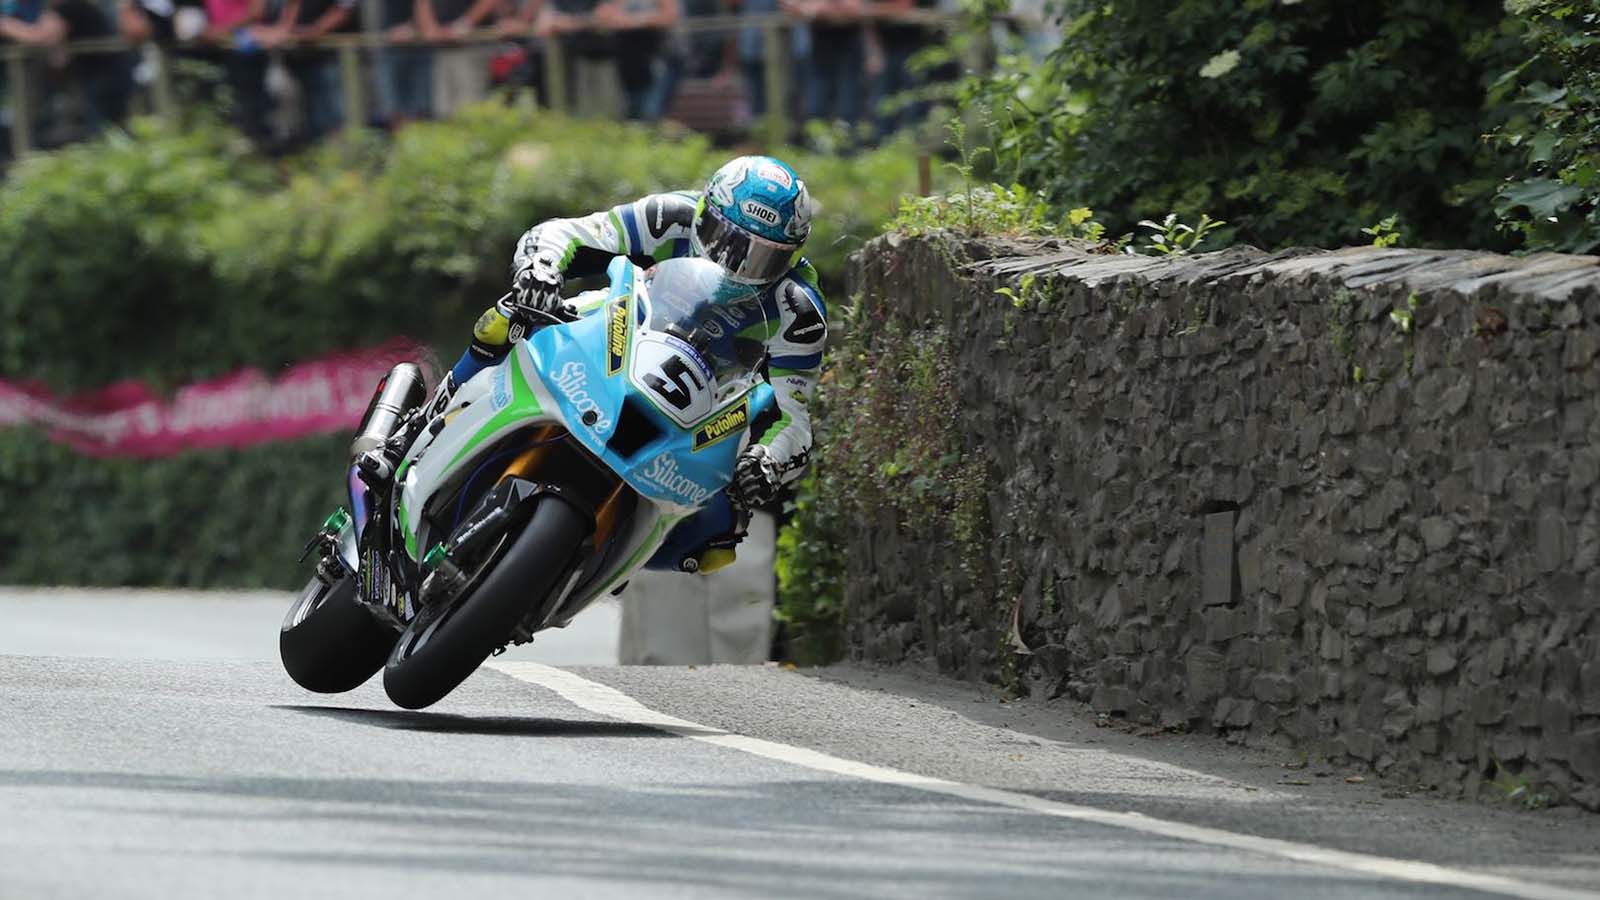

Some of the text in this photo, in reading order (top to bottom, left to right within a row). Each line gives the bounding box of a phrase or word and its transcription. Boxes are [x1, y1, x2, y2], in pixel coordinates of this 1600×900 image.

[746, 203, 777, 223] SHOEI
[612, 306, 627, 357] Putoline
[641, 354, 704, 411] 5
[703, 408, 746, 440] Putoline
[643, 450, 707, 503] Silicone
